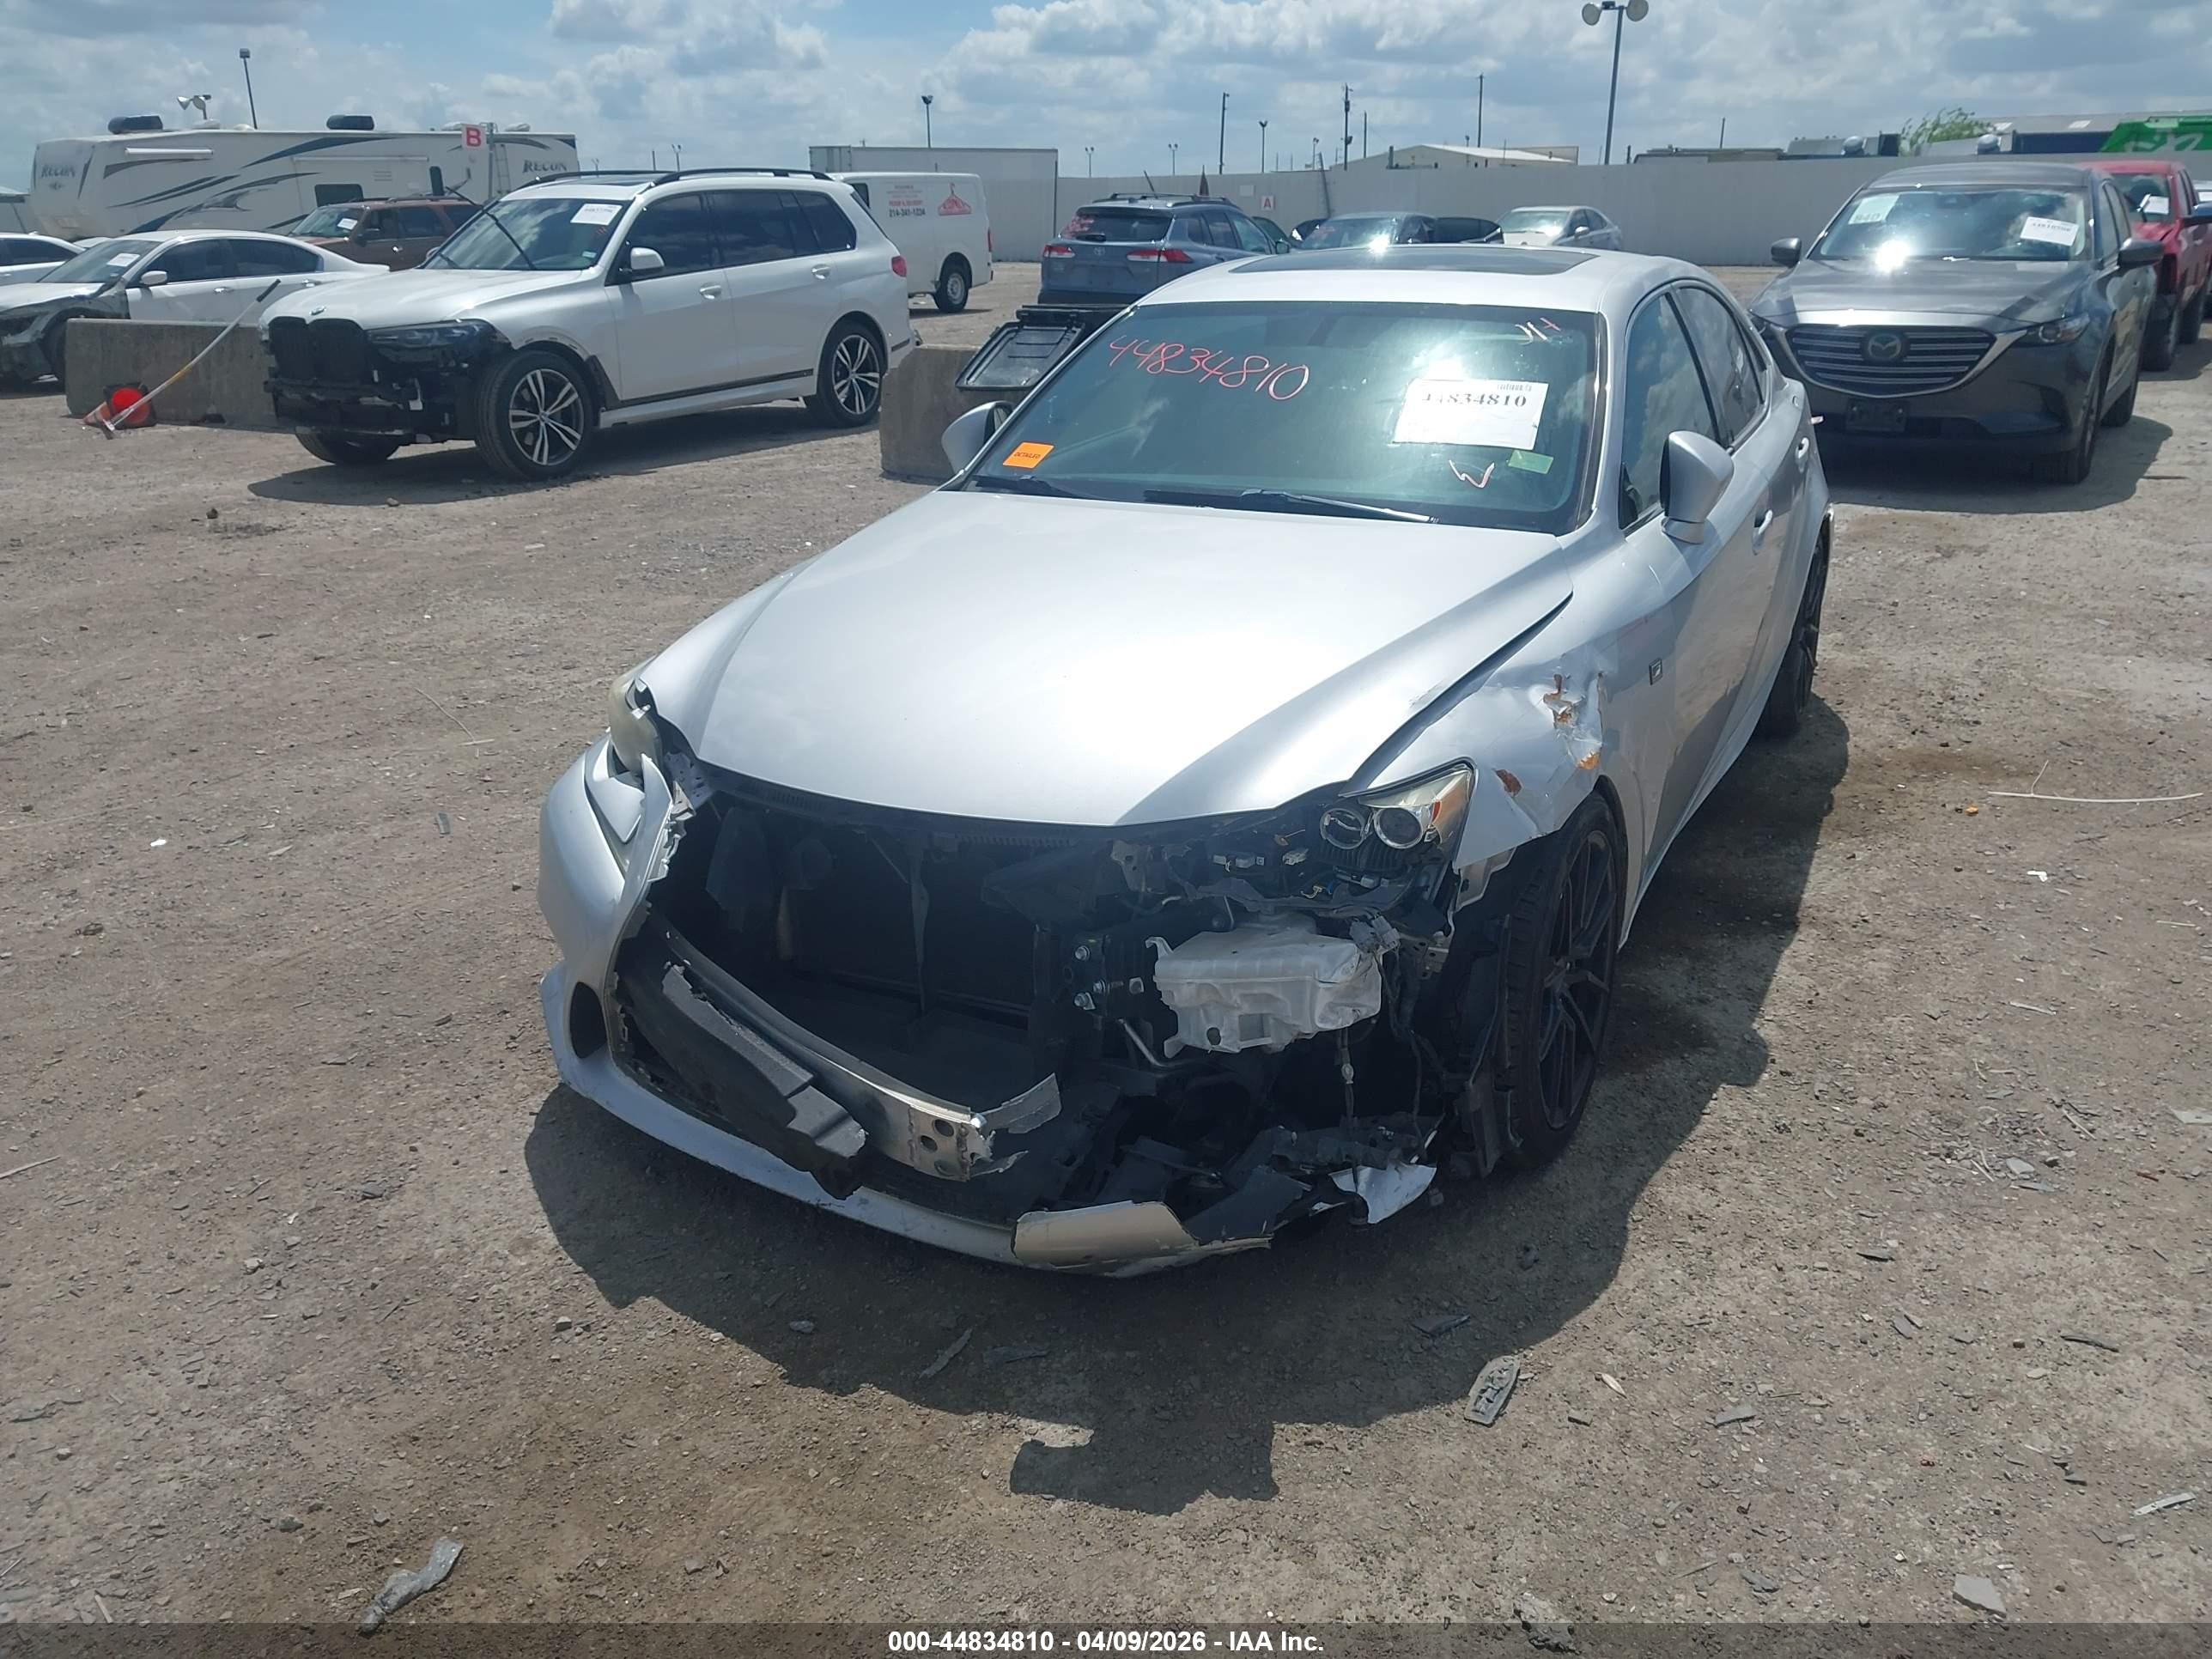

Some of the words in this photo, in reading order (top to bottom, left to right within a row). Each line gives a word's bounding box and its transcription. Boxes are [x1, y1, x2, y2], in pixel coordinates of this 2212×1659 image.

[465, 127, 482, 147] B
[40, 164, 76, 178] RECON
[523, 160, 567, 173] RECON
[1263, 198, 1272, 208] A
[1109, 335, 1310, 400] 44834810
